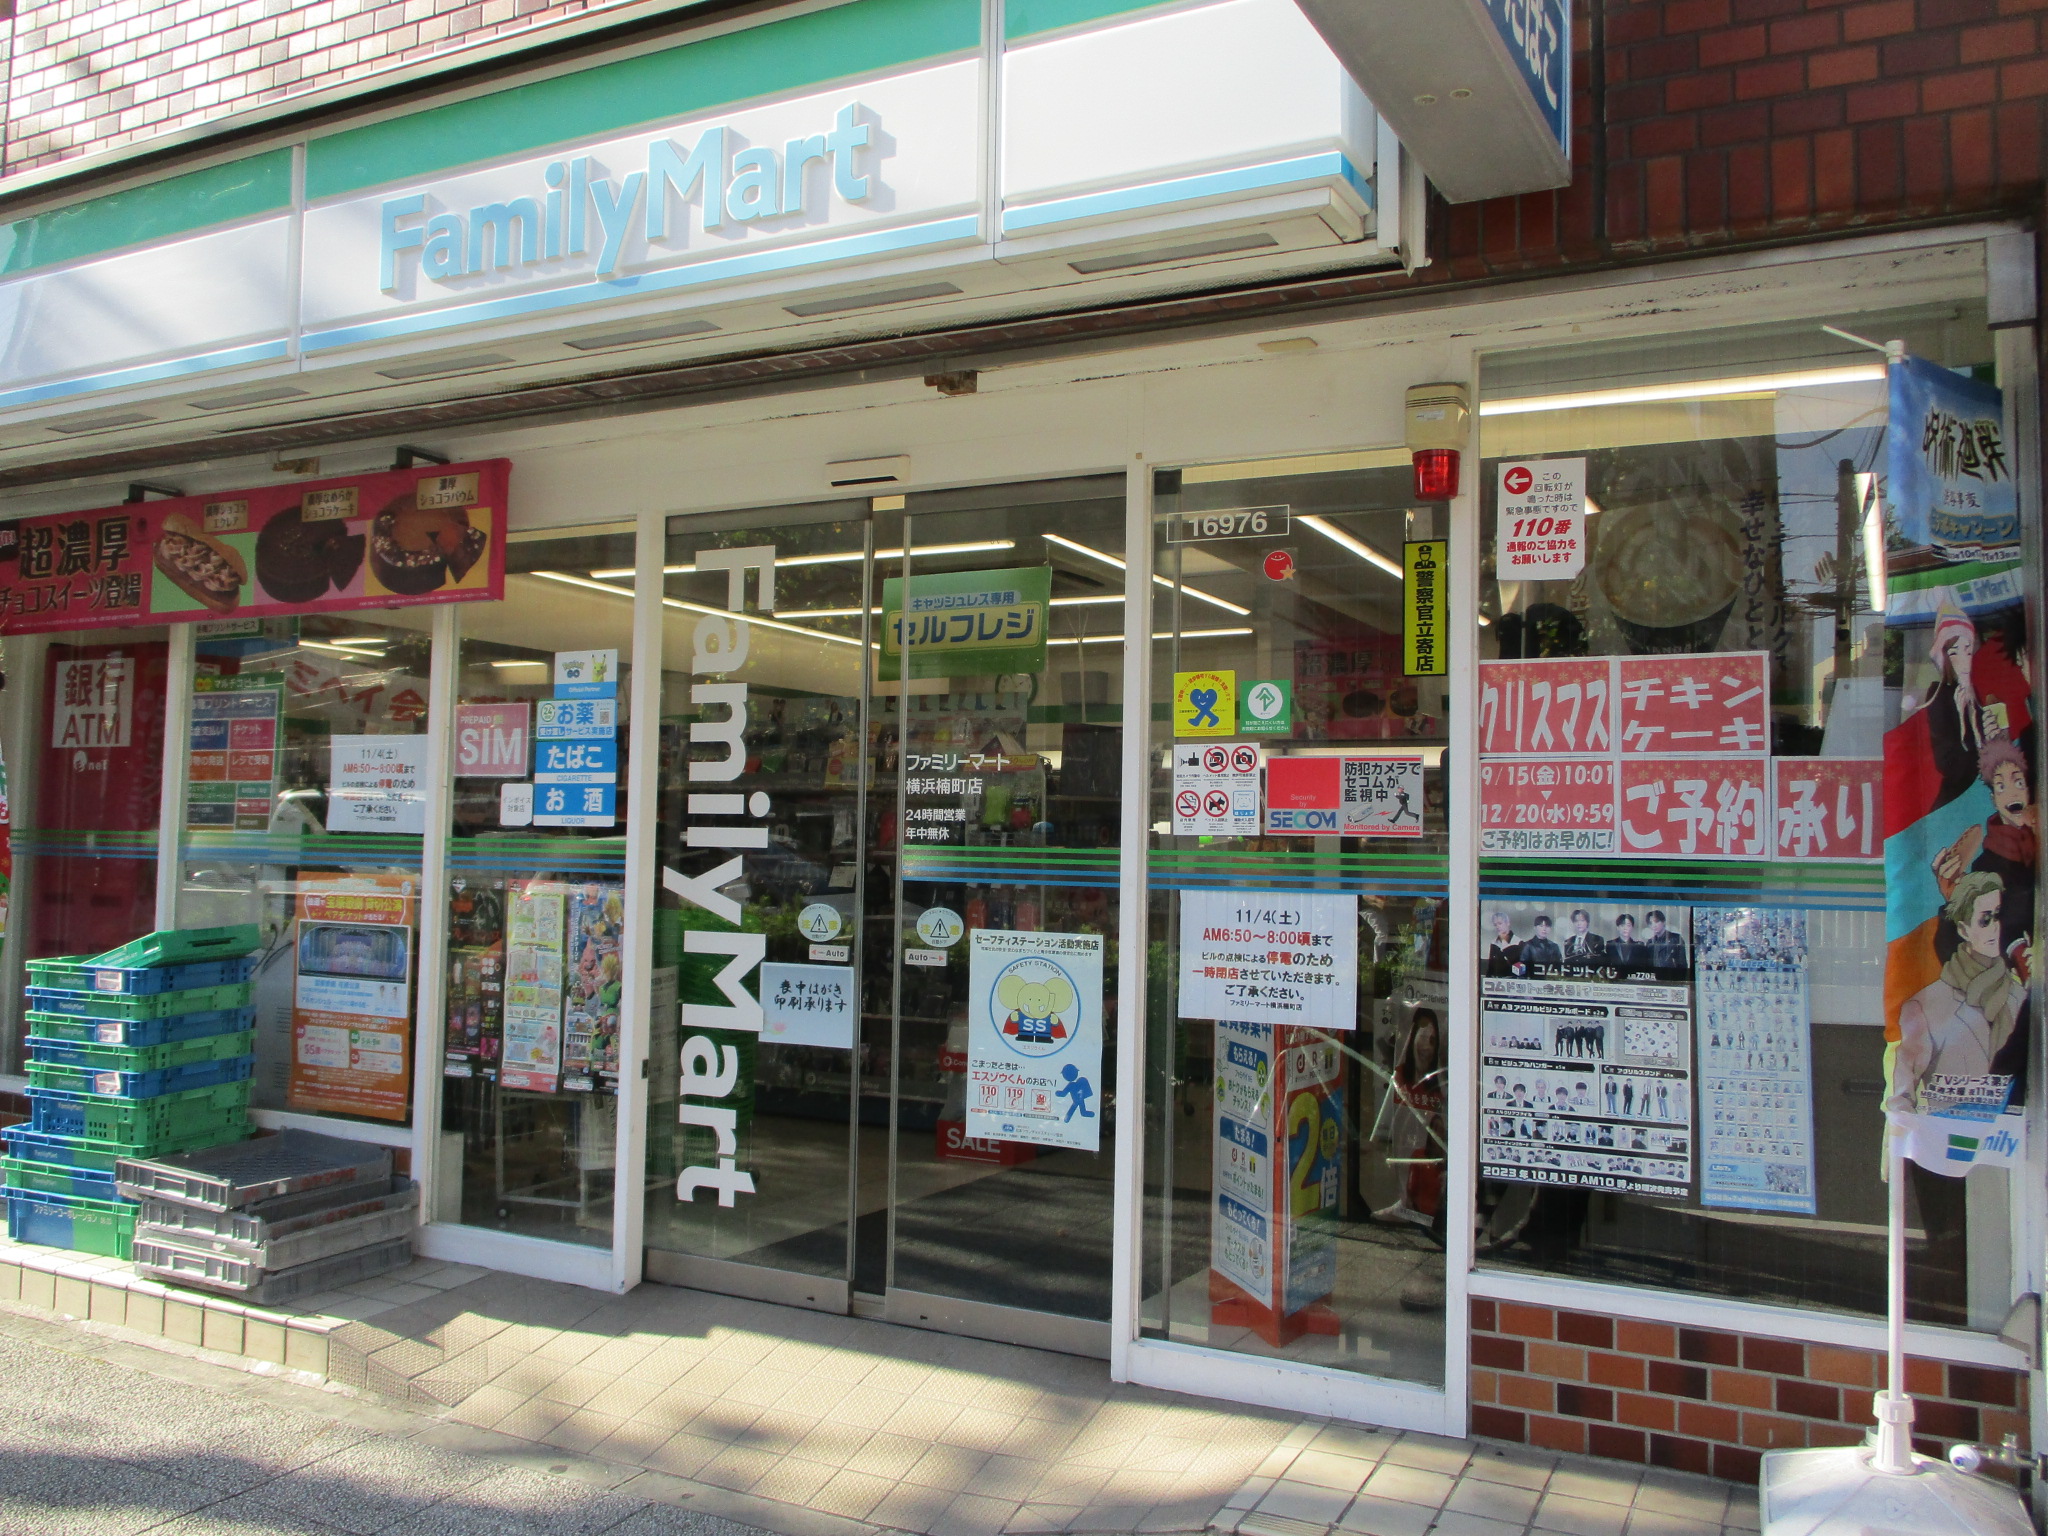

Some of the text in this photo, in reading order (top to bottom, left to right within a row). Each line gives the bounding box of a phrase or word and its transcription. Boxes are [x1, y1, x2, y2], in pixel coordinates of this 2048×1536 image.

[379, 101, 869, 294] FamilyMart
[1542, 472, 1561, 480] この
[1534, 482, 1573, 493] 回転灯が
[1527, 493, 1573, 504] 鳴った時は
[1505, 503, 1578, 516] 緊急事態ですので
[1188, 513, 1268, 538] 16976
[1512, 517, 1572, 537] 110番
[19, 516, 130, 580] 超濃厚
[1506, 539, 1577, 552] 通報のご協力を
[1511, 552, 1572, 565] お願いします
[0, 573, 142, 615] チョコスイーツ登場
[912, 591, 1015, 610] キャッシュレス専用
[893, 608, 1035, 646] セルフレジ
[1414, 569, 1435, 673] 警察官立寄店
[65, 662, 125, 706] 銀行
[1621, 675, 1764, 712] チキン
[460, 715, 492, 724] PREPAID
[557, 702, 595, 726] お薬
[1478, 679, 1610, 752] クリスマス
[62, 713, 121, 744] ATM
[233, 725, 261, 735] チケット
[1622, 716, 1765, 752] ケーキ
[361, 749, 398, 760] 11/4(土)
[459, 728, 522, 766] SIM
[547, 744, 602, 769] たばこ
[906, 753, 1010, 772] ファミリーマート
[1344, 762, 1421, 776] 防犯カメラで
[906, 777, 983, 795] 横浜楠町店
[1345, 775, 1399, 789] セコムが
[545, 788, 603, 812] お酒
[1291, 794, 1316, 802] Security
[1344, 788, 1388, 802] 監視中
[508, 805, 525, 813] 対象店
[905, 808, 966, 822] 24時間営業
[1621, 777, 1872, 856] ご予約 承り
[1270, 811, 1337, 829] SECOM
[1381, 824, 1391, 832] by
[905, 826, 950, 840] 年中無休
[1481, 830, 1613, 852] ご予約はお早めに!
[663, 545, 776, 1208] FamilyMart
[802, 920, 811, 929] 注
[1236, 909, 1301, 926] 11/4(土)
[920, 924, 931, 934] 注
[975, 934, 1099, 950] セーフティステーション活動実施店
[826, 950, 844, 958] Auto
[908, 953, 928, 961] Auto
[1202, 952, 1333, 967] ビルの点検による停電のため
[1008, 960, 1062, 976] SAFETY STATION
[1192, 967, 1340, 986] 一時閉店させていただきます。
[1534, 964, 1618, 979] コムドットくじ
[779, 980, 842, 998] 喪中はがき
[1225, 984, 1304, 1001] ご了承ください。
[58, 1002, 85, 1011] FamilyMart
[774, 995, 847, 1013] 印刷承ります
[1022, 1018, 1047, 1032] SS
[1233, 1048, 1257, 1069] もらえる!
[971, 1071, 1057, 1087] エスゾウくんのお店へ!
[981, 1086, 1023, 1099] 110 119
[58, 1102, 83, 1112] FamilyMart
[946, 1128, 1000, 1153] SALE
[1233, 1127, 1255, 1149] たまる!
